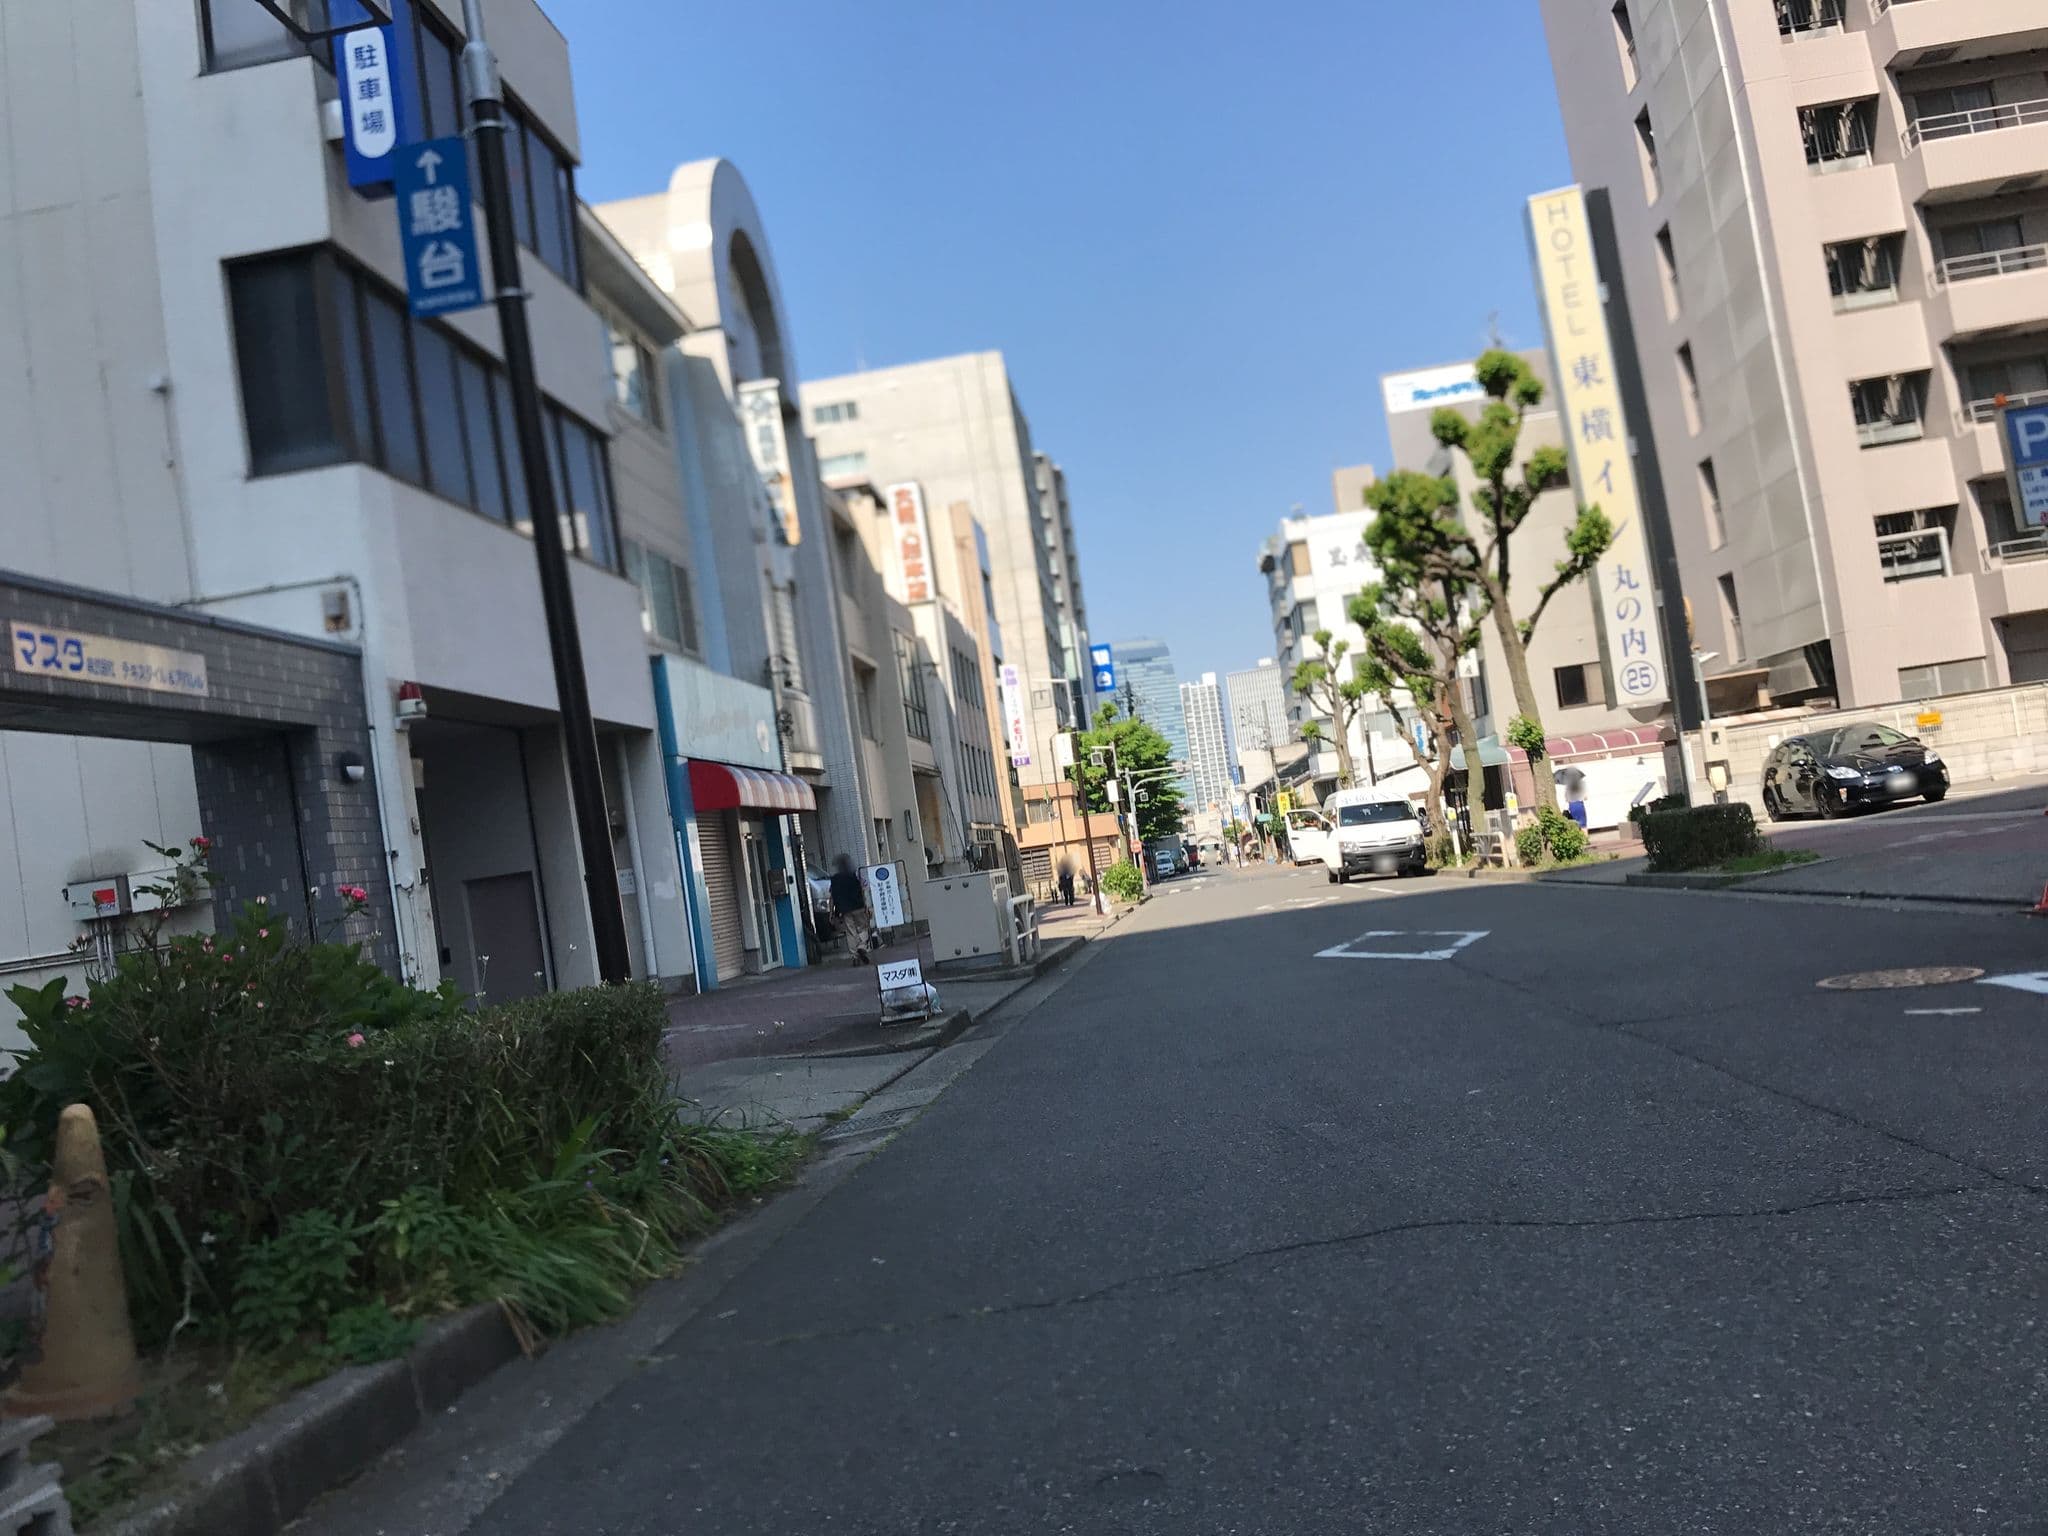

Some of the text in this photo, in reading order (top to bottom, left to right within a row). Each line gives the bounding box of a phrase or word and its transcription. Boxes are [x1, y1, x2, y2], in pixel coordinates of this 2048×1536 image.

[353, 44, 387, 135] 駐車場
[410, 184, 466, 290] 駿台
[1546, 200, 1587, 336] HOTEL
[2015, 413, 2048, 459] P
[1614, 563, 1648, 658] 丸の内
[1626, 667, 1651, 690] 25
